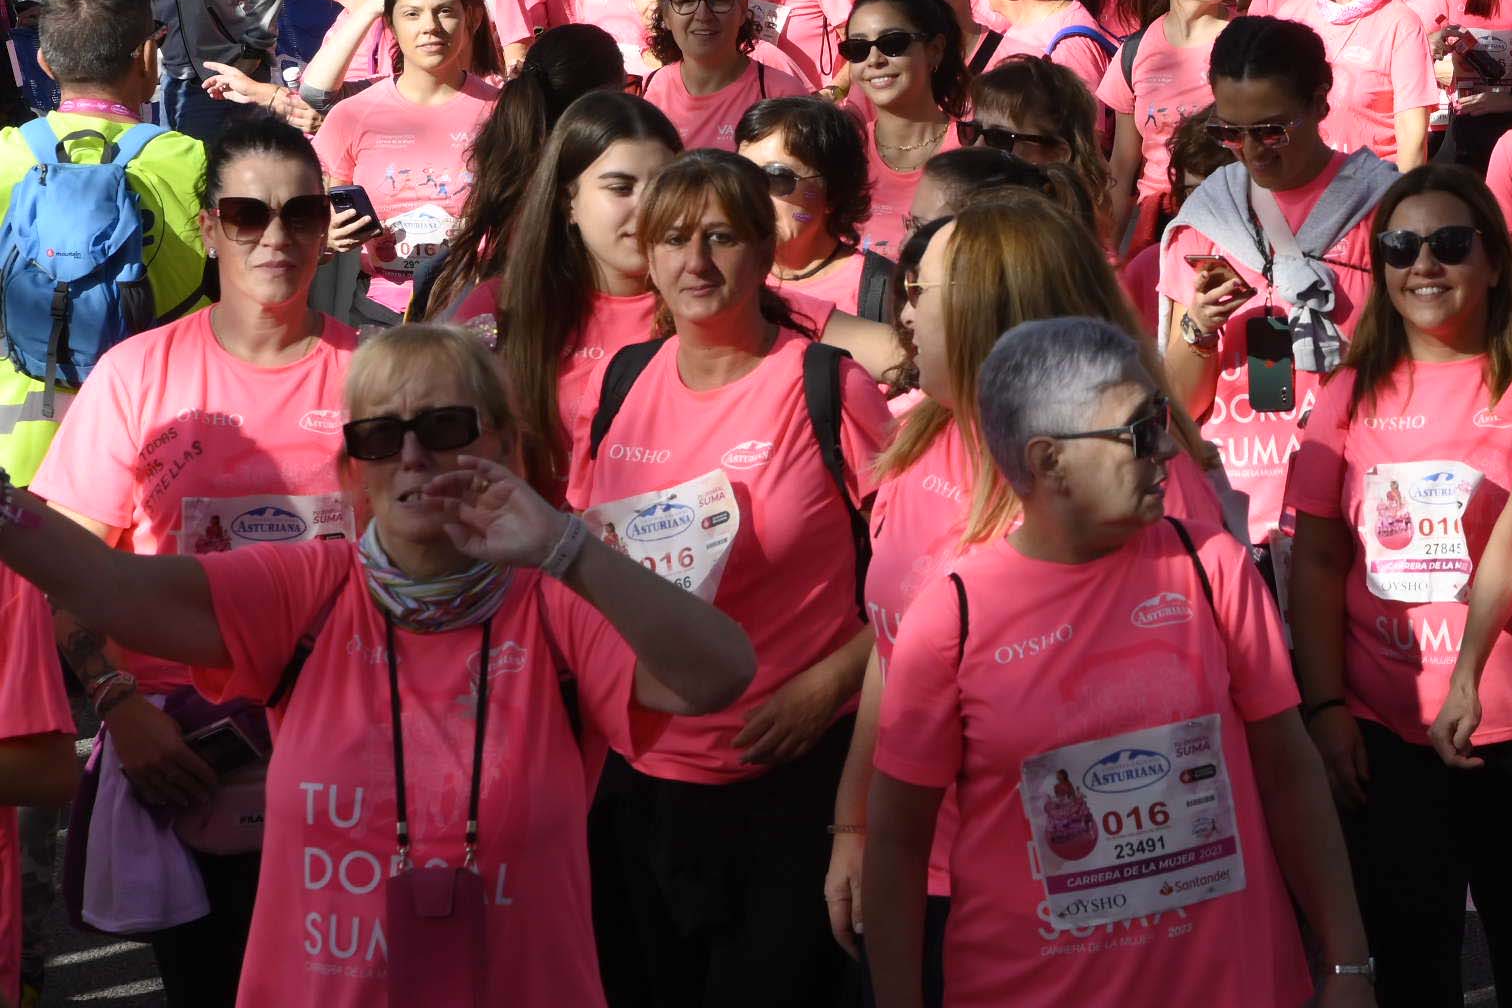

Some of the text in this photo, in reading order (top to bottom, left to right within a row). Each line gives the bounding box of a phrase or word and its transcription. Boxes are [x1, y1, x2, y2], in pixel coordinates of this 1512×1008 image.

[401, 242, 436, 258] 016
[177, 407, 244, 428] OYSHO
[1364, 415, 1426, 430] OYSHO
[138, 427, 179, 462] TODAS
[609, 443, 671, 464] OYSHO
[699, 491, 726, 508] SUMA
[237, 520, 301, 533] ASTURIANA
[631, 513, 691, 537] ASTURIANA
[1419, 517, 1460, 537] 01
[994, 623, 1073, 664] OYSHO
[1175, 740, 1212, 758] SUMA
[1090, 763, 1165, 787] ASTURIANA
[299, 781, 365, 828] TU
[1102, 801, 1171, 836] 016
[1114, 835, 1167, 860] 23491
[1067, 870, 1121, 888] CARRERA
[1124, 865, 1140, 877] DE
[1142, 860, 1157, 872] LA
[1159, 853, 1196, 871] MUJER
[1174, 868, 1232, 893] Santander
[1065, 894, 1127, 917] OYSHO
